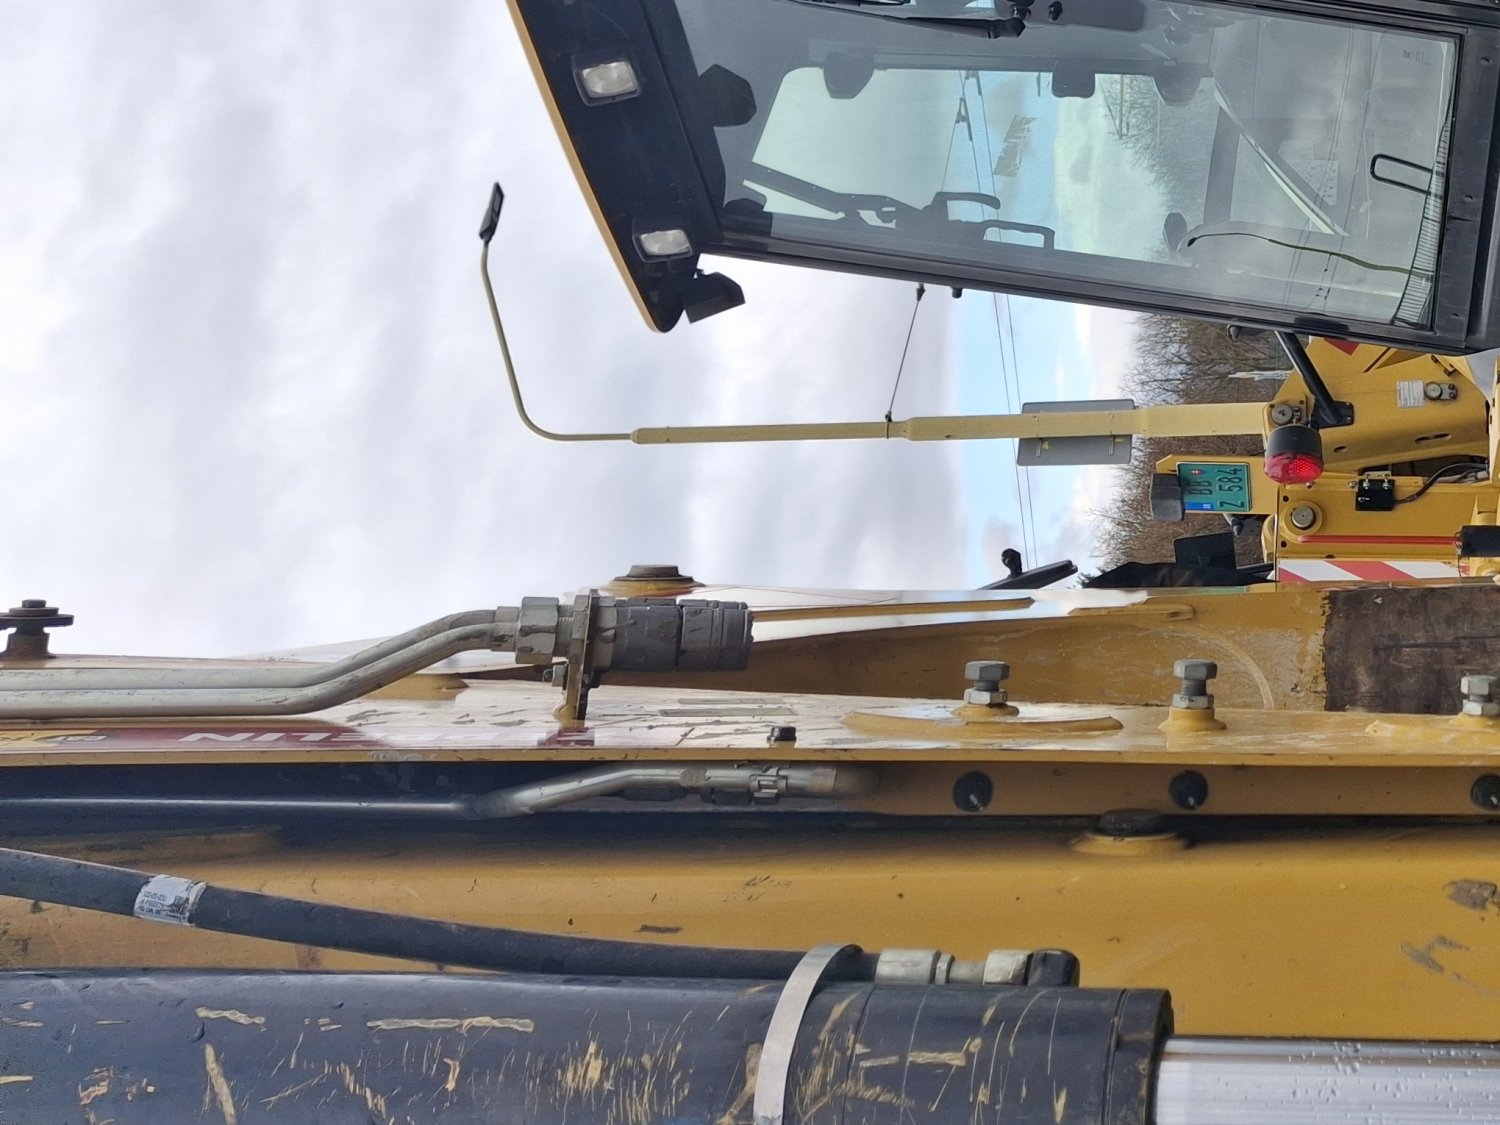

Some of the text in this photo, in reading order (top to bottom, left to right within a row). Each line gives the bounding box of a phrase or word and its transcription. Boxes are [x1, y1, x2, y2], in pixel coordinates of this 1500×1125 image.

[1186, 480, 1213, 495] BB
[1216, 467, 1244, 508] Z 584
